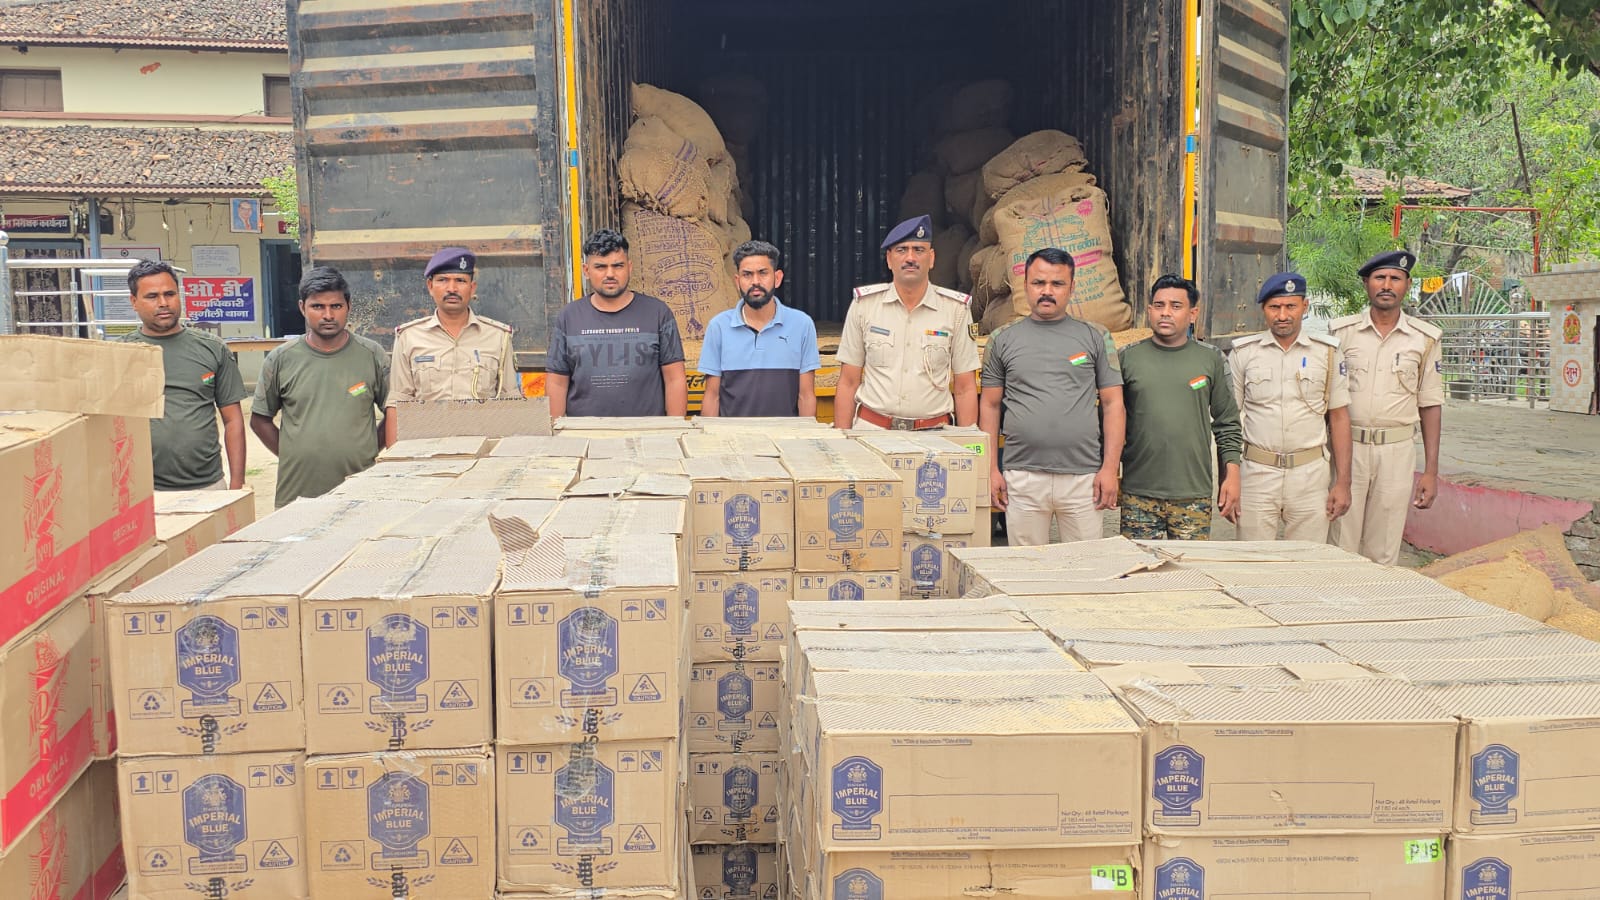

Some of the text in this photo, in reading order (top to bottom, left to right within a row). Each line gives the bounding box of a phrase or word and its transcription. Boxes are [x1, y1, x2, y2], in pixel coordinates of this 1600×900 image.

[191, 298, 245, 308] पदाधिकारी
[225, 310, 250, 318] थाना
[918, 481, 945, 490] IMPERIAL
[728, 515, 757, 525] IMPERIAL
[26, 569, 66, 605] ORIGINAL
[726, 604, 756, 613] IMPERIAL
[183, 653, 234, 669] IMPERIAL
[372, 651, 424, 666] IMPERIAL
[195, 666, 222, 676] BLUE
[384, 663, 411, 672] BLUE
[720, 693, 750, 702] IMPERIAL
[1157, 775, 1199, 787] IMPERIAL
[1475, 773, 1516, 788] IMPERIAL
[1167, 784, 1189, 792] BLUE
[1484, 783, 1505, 792] BLUE
[835, 787, 879, 800] IMPERIAL
[560, 794, 609, 808] IMPERIAL
[845, 797, 868, 805] BLUE
[571, 805, 597, 815] BLUE
[189, 812, 240, 828] IMPERIAL
[374, 809, 424, 823] IMPERIAL
[202, 824, 229, 833] BLUE
[386, 820, 412, 829] BLUE
[725, 866, 755, 875] IMPERIAL
[1158, 887, 1200, 899] IMPERIAL
[1466, 885, 1507, 899] IMPERIAL
